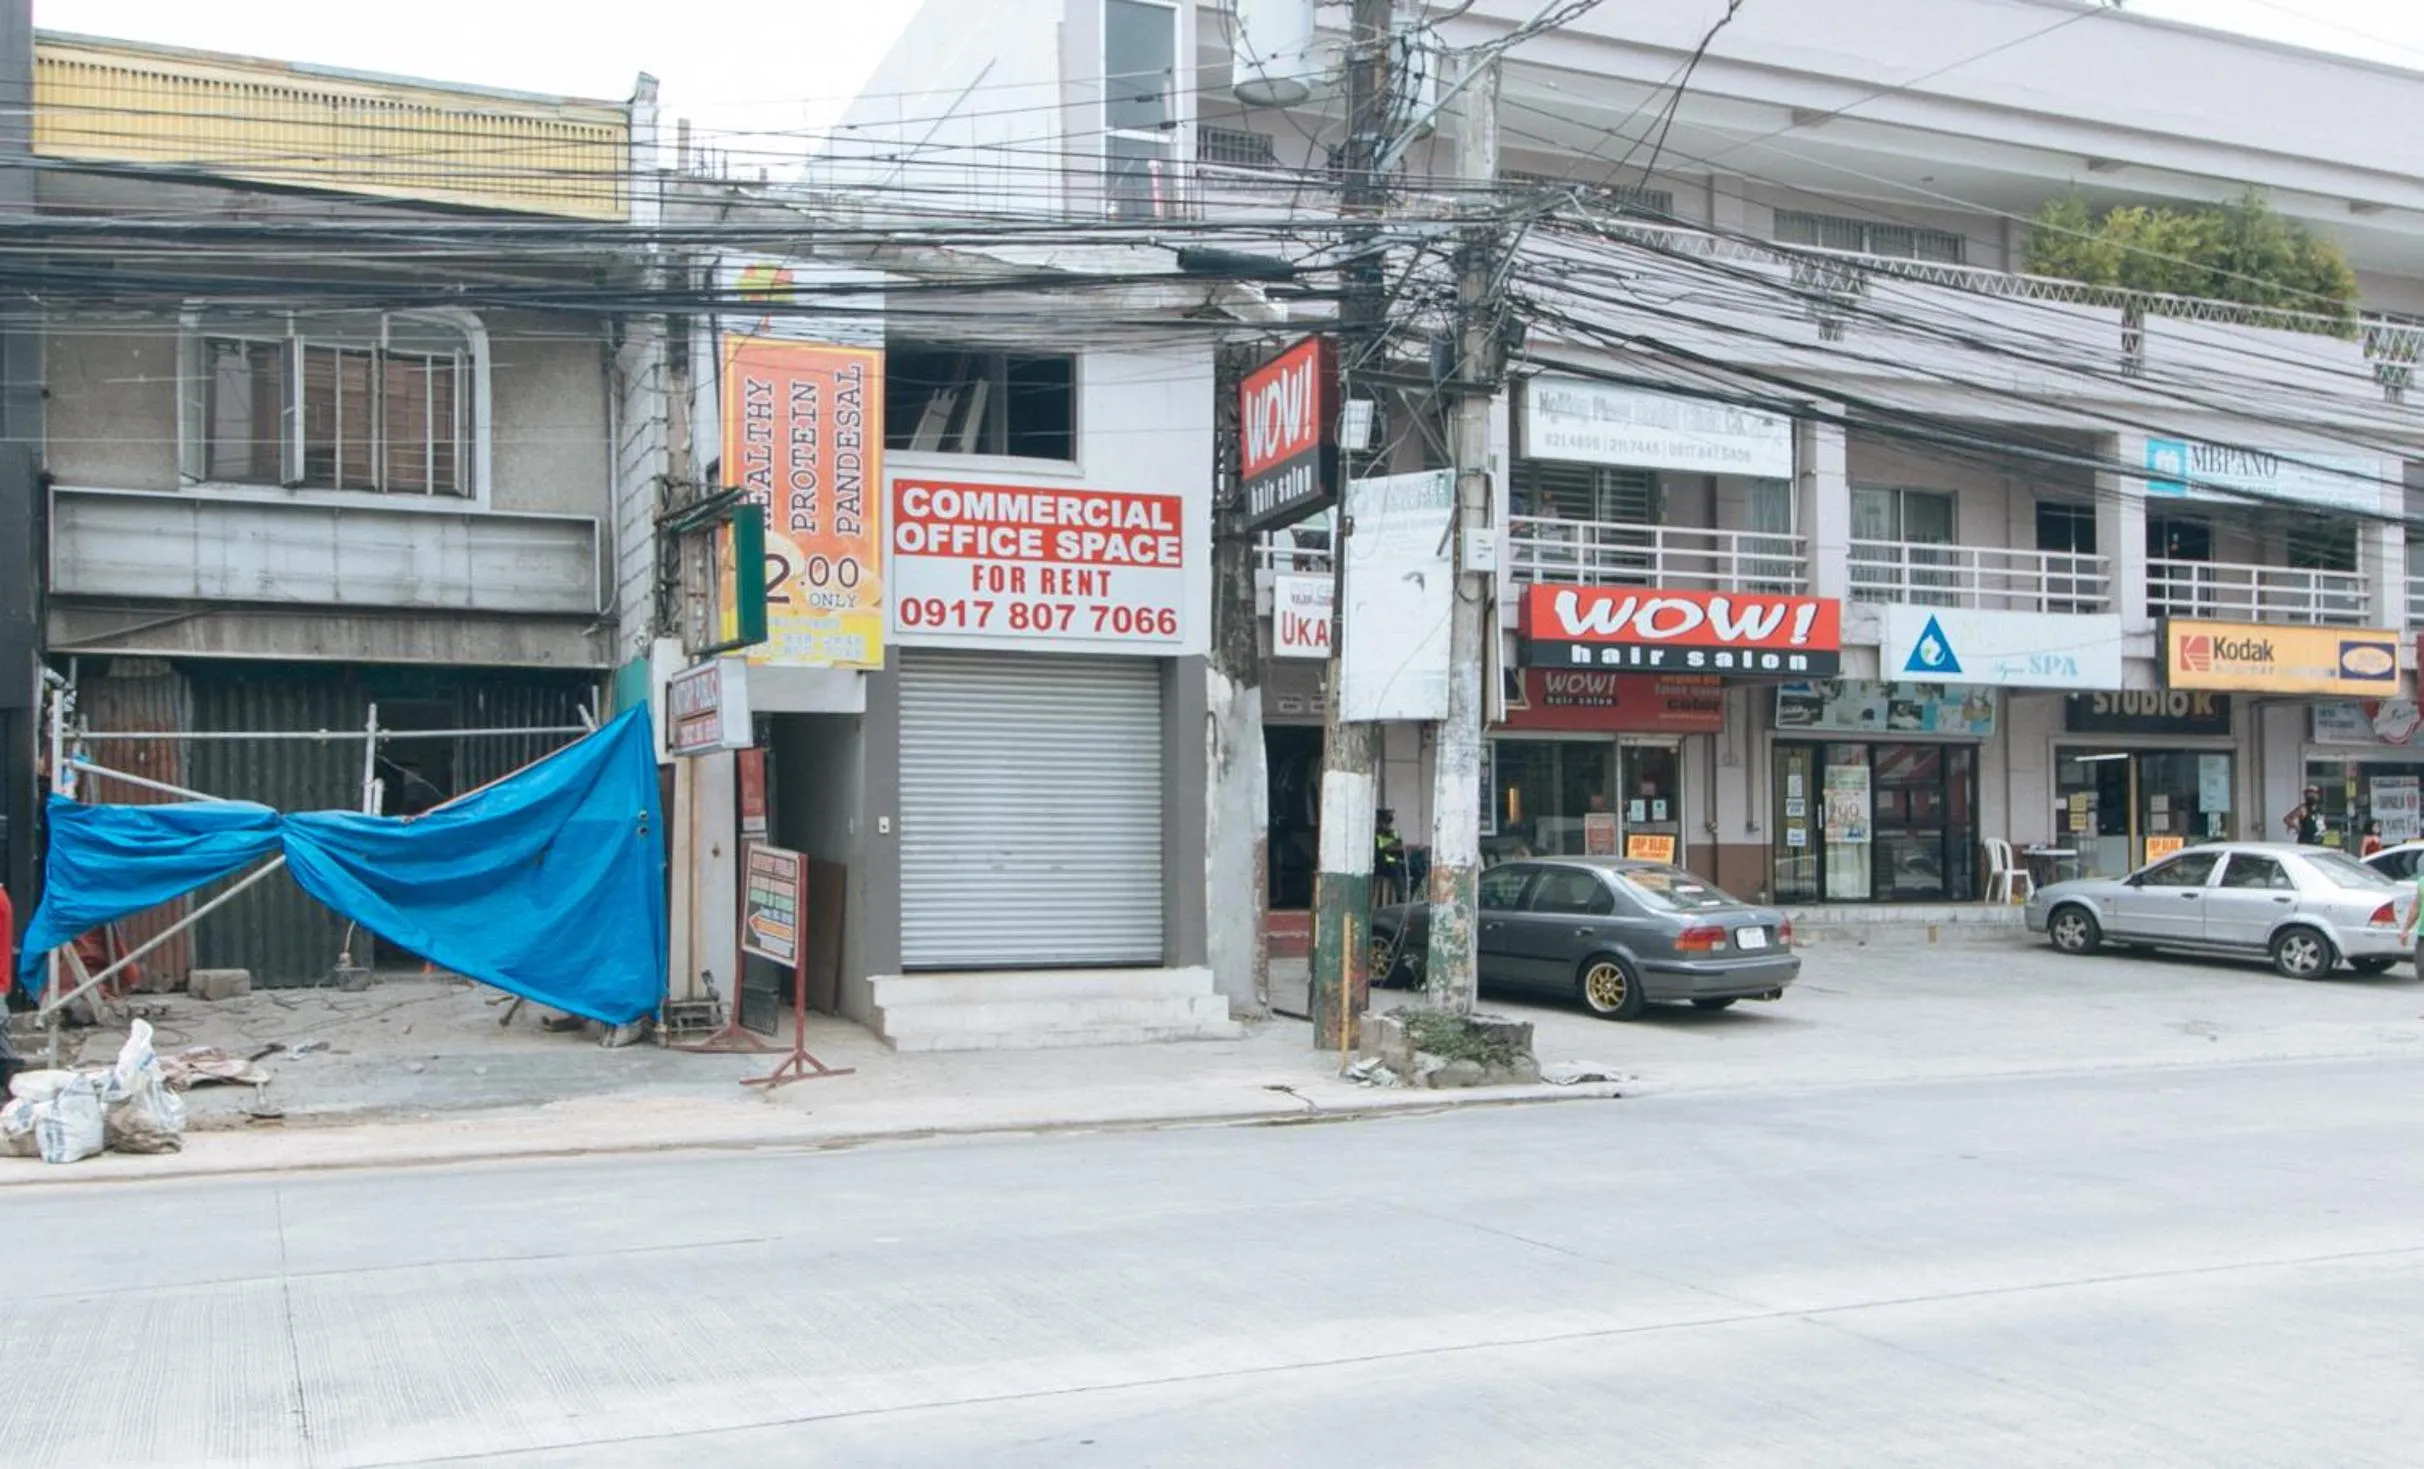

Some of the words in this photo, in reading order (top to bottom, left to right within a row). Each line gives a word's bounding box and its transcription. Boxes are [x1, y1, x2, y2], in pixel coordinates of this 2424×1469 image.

[1246, 354, 1313, 468] WOW!
[791, 382, 816, 531] PROTEIN
[836, 365, 860, 534] PANDESAL
[902, 487, 1173, 531] COMMERCIAL
[1252, 479, 1275, 516] hair
[1278, 464, 1312, 503] salon
[895, 521, 1043, 558] OFFICE
[1055, 529, 1180, 565] SPACE
[808, 592, 857, 608] ONLY
[972, 564, 1026, 595] FOR
[1040, 567, 1111, 598] RENT
[900, 597, 994, 628] 0917
[1008, 602, 1076, 631] 807
[1089, 605, 1178, 635] 7066
[1554, 590, 1818, 645] WOW!
[1571, 644, 1665, 666] hair
[1686, 650, 1808, 671] salon
[2029, 655, 2079, 677] SPA
[2212, 637, 2275, 662] Kodak
[1545, 672, 1617, 694] WOW!
[2093, 692, 2188, 717] STUDIO
